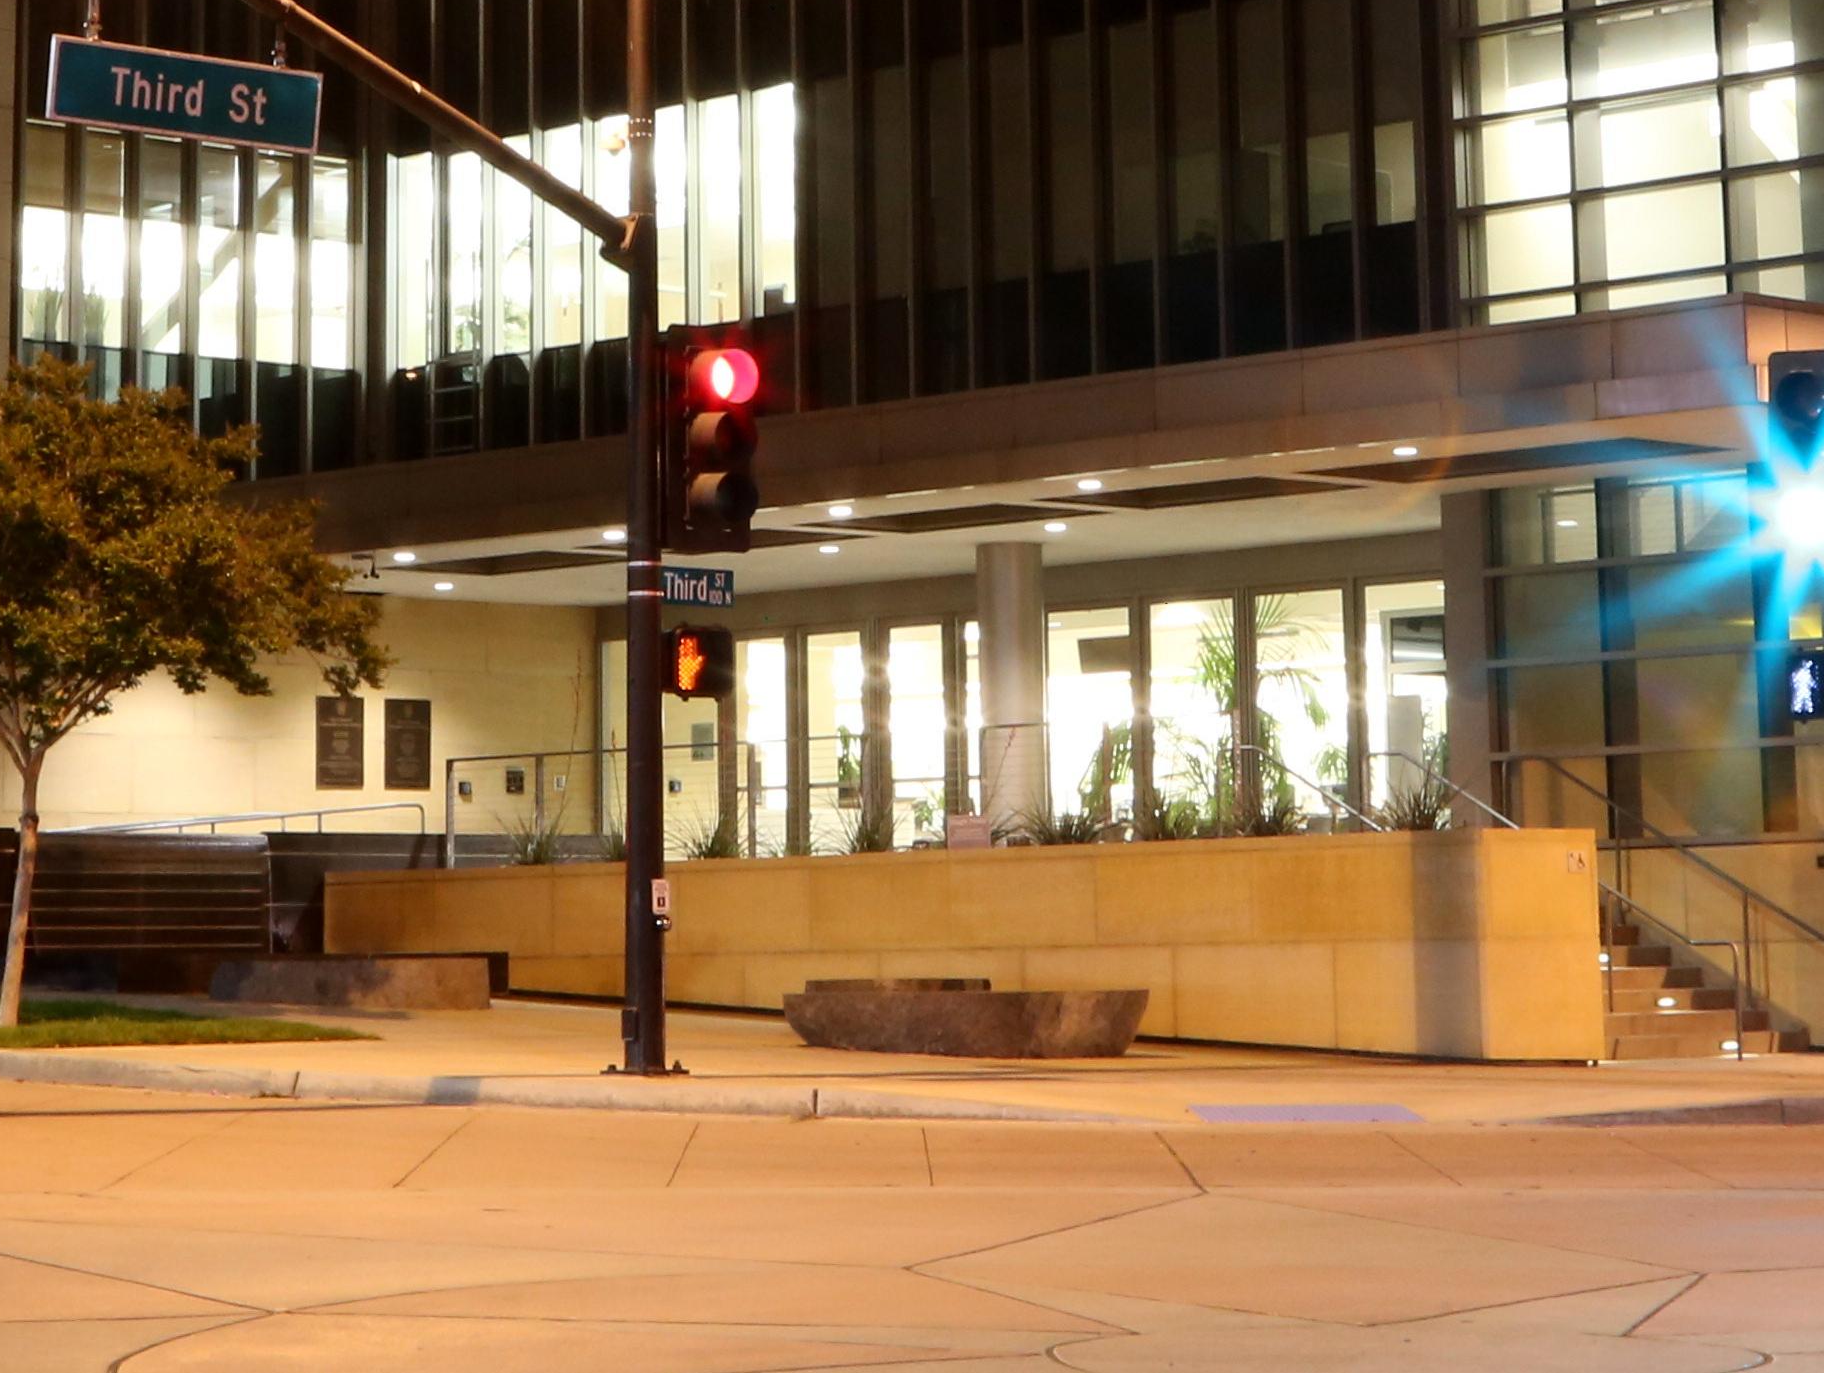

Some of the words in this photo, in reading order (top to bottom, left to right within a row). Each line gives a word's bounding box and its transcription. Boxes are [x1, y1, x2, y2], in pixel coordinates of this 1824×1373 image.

[110, 65, 205, 118] Third
[228, 83, 268, 126] St
[664, 572, 708, 602] Third
